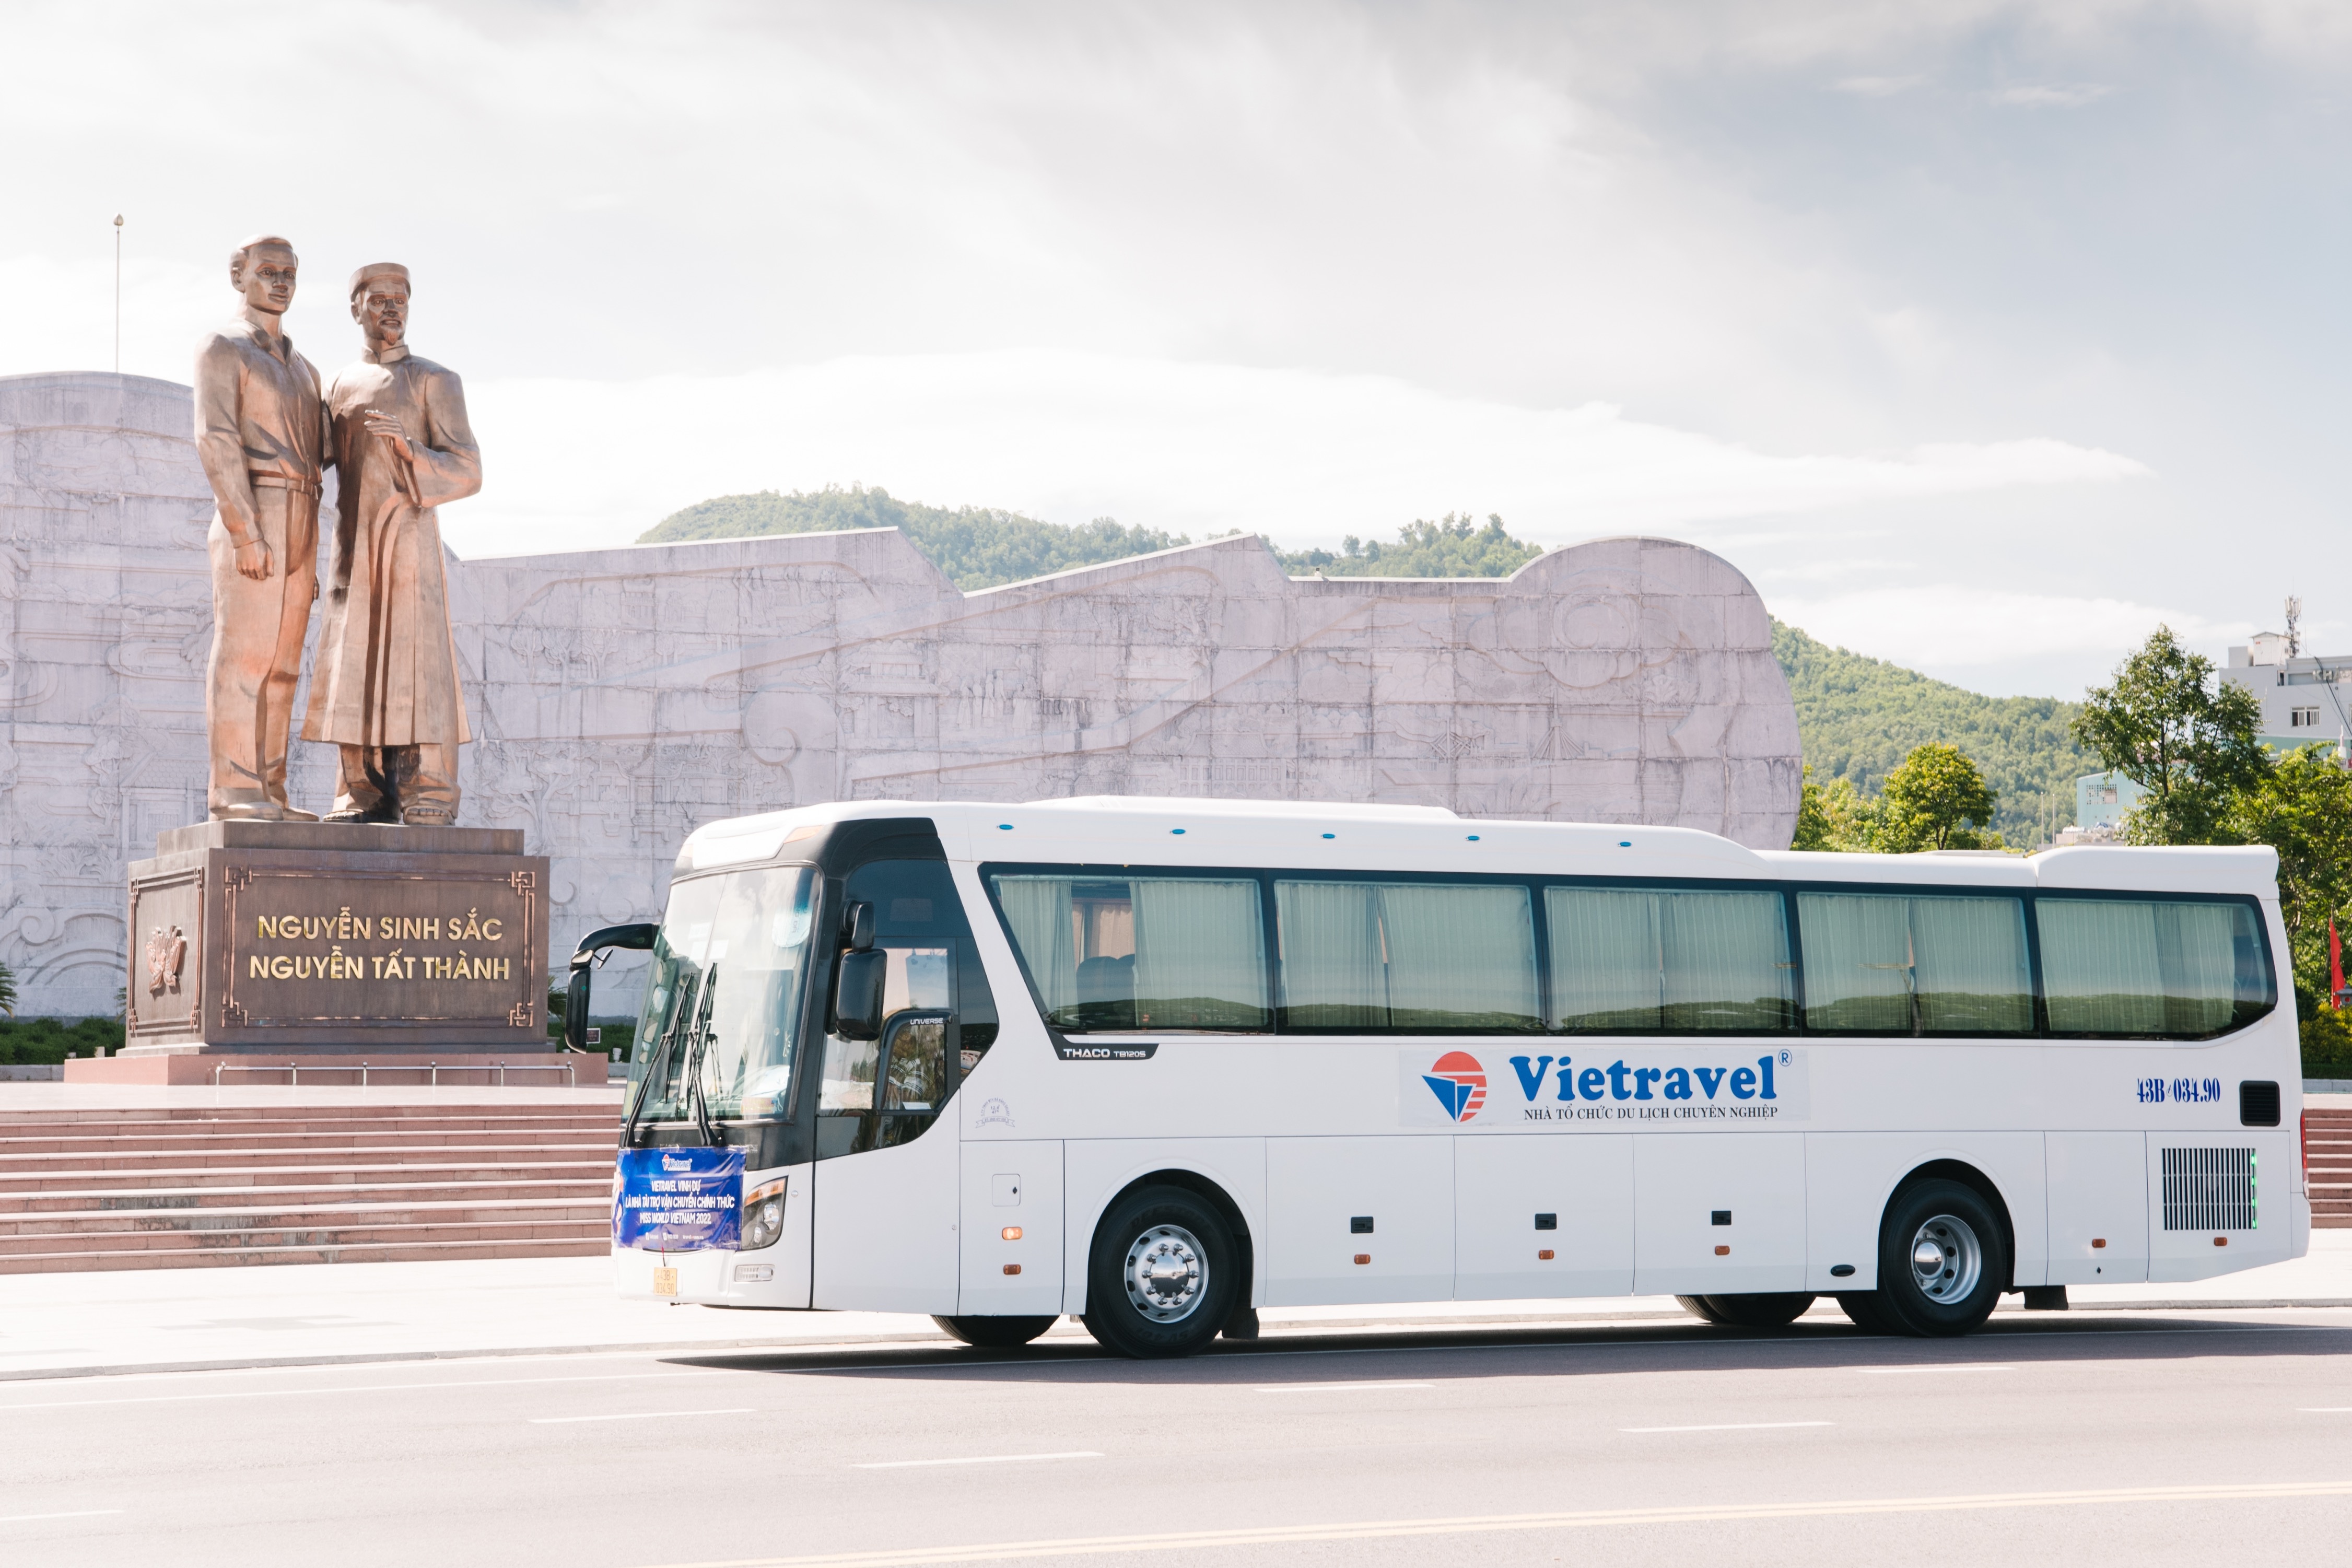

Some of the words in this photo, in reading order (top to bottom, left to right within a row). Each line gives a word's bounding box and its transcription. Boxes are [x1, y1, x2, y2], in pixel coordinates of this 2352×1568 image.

[258, 906, 371, 940] NGUYỄN
[379, 917, 439, 940] SINH
[447, 907, 502, 941] SẮC
[250, 945, 364, 979] NGUYỄN
[371, 948, 416, 979] TẤT
[422, 950, 510, 980] THÀNH
[1063, 1048, 1110, 1058] THACO
[1524, 1106, 1552, 1120] NHÀ
[1556, 1103, 1573, 1120] TỔ
[1577, 1105, 1613, 1119] CHỨC
[1617, 1107, 1636, 1119] DU
[1639, 1107, 1670, 1121] LỊCH
[1674, 1104, 1726, 1119] CHUYÊN
[1729, 1104, 1778, 1120] NGHIỆP
[651, 1180, 677, 1192] VIETRAVEL
[678, 1180, 691, 1192] VINH
[692, 1179, 701, 1195] DỰ
[625, 1193, 631, 1208] LÀ
[631, 1193, 641, 1208] NHÀ
[650, 1195, 661, 1211] TRỢ
[661, 1193, 673, 1211] VẬN
[673, 1191, 696, 1208] CHUYỂN
[697, 1193, 716, 1208] CHÍNH
[717, 1193, 735, 1208] THỨC
[640, 1212, 651, 1224] MISS
[651, 1212, 670, 1224] WORLD
[670, 1212, 696, 1224] VIETNAM
[696, 1212, 711, 1224] 2022
[660, 1270, 670, 1280] 43B
[657, 1283, 674, 1294] 034.90
